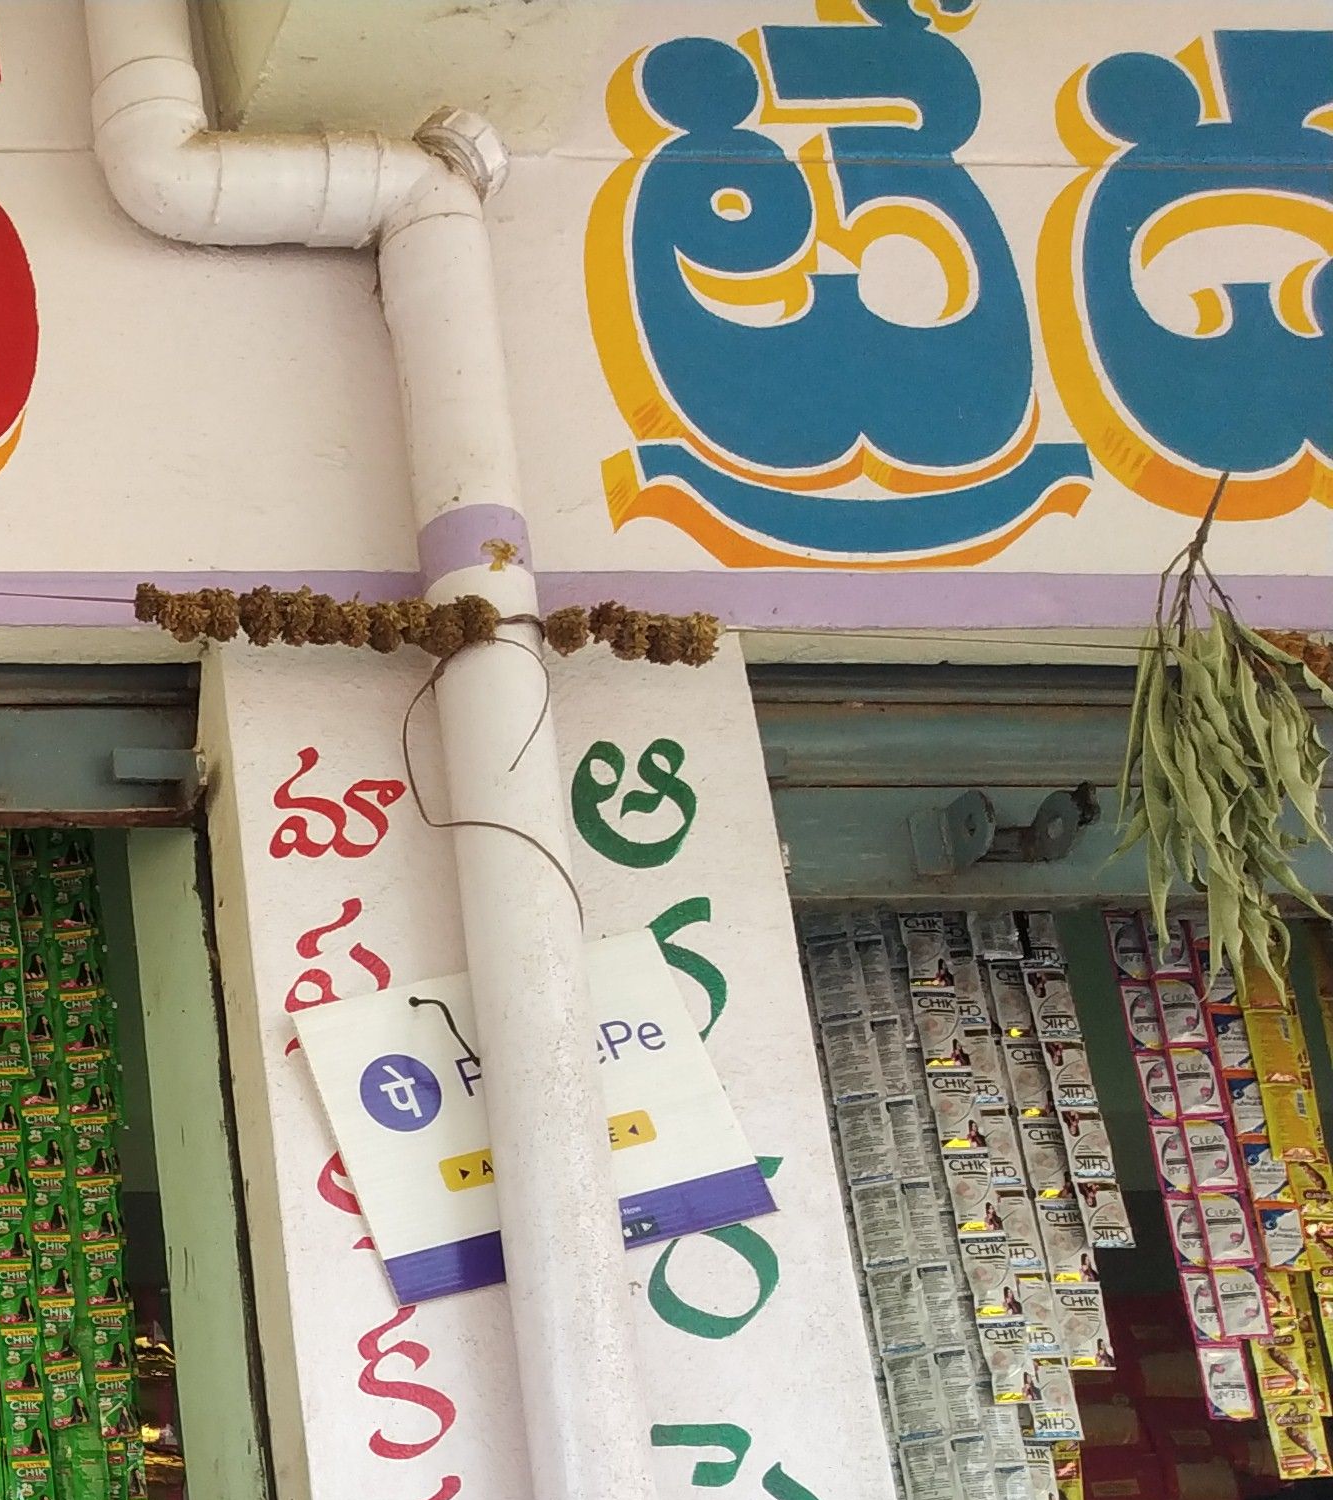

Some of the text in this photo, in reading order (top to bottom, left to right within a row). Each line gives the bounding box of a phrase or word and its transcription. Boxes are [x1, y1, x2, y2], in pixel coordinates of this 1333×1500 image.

[269, 747, 406, 859] మా
[904, 915, 942, 931] CHIK
[918, 994, 956, 1011] CHIK
[1040, 1015, 1077, 1032] CHIK
[932, 1076, 971, 1094] CHIK
[1059, 1084, 1093, 1102] CHIK
[948, 1158, 988, 1175] CHIK
[1074, 1156, 1111, 1173] CHIK
[1044, 1208, 1082, 1225] CHIK
[1092, 1226, 1130, 1243] CHIK
[37, 1240, 66, 1253] CHIK
[965, 1240, 1006, 1258] CHIK
[86, 1250, 116, 1264] CHIK
[1059, 1294, 1100, 1310] CHIK
[91, 1314, 123, 1328] CHIK
[4, 1333, 34, 1347] CHIK
[983, 1326, 1024, 1343] CHIK
[95, 1380, 126, 1393] CHIK
[10, 1399, 40, 1413] CHIK
[1036, 1415, 1078, 1433] CHIK
[16, 1466, 47, 1480] CHIK
